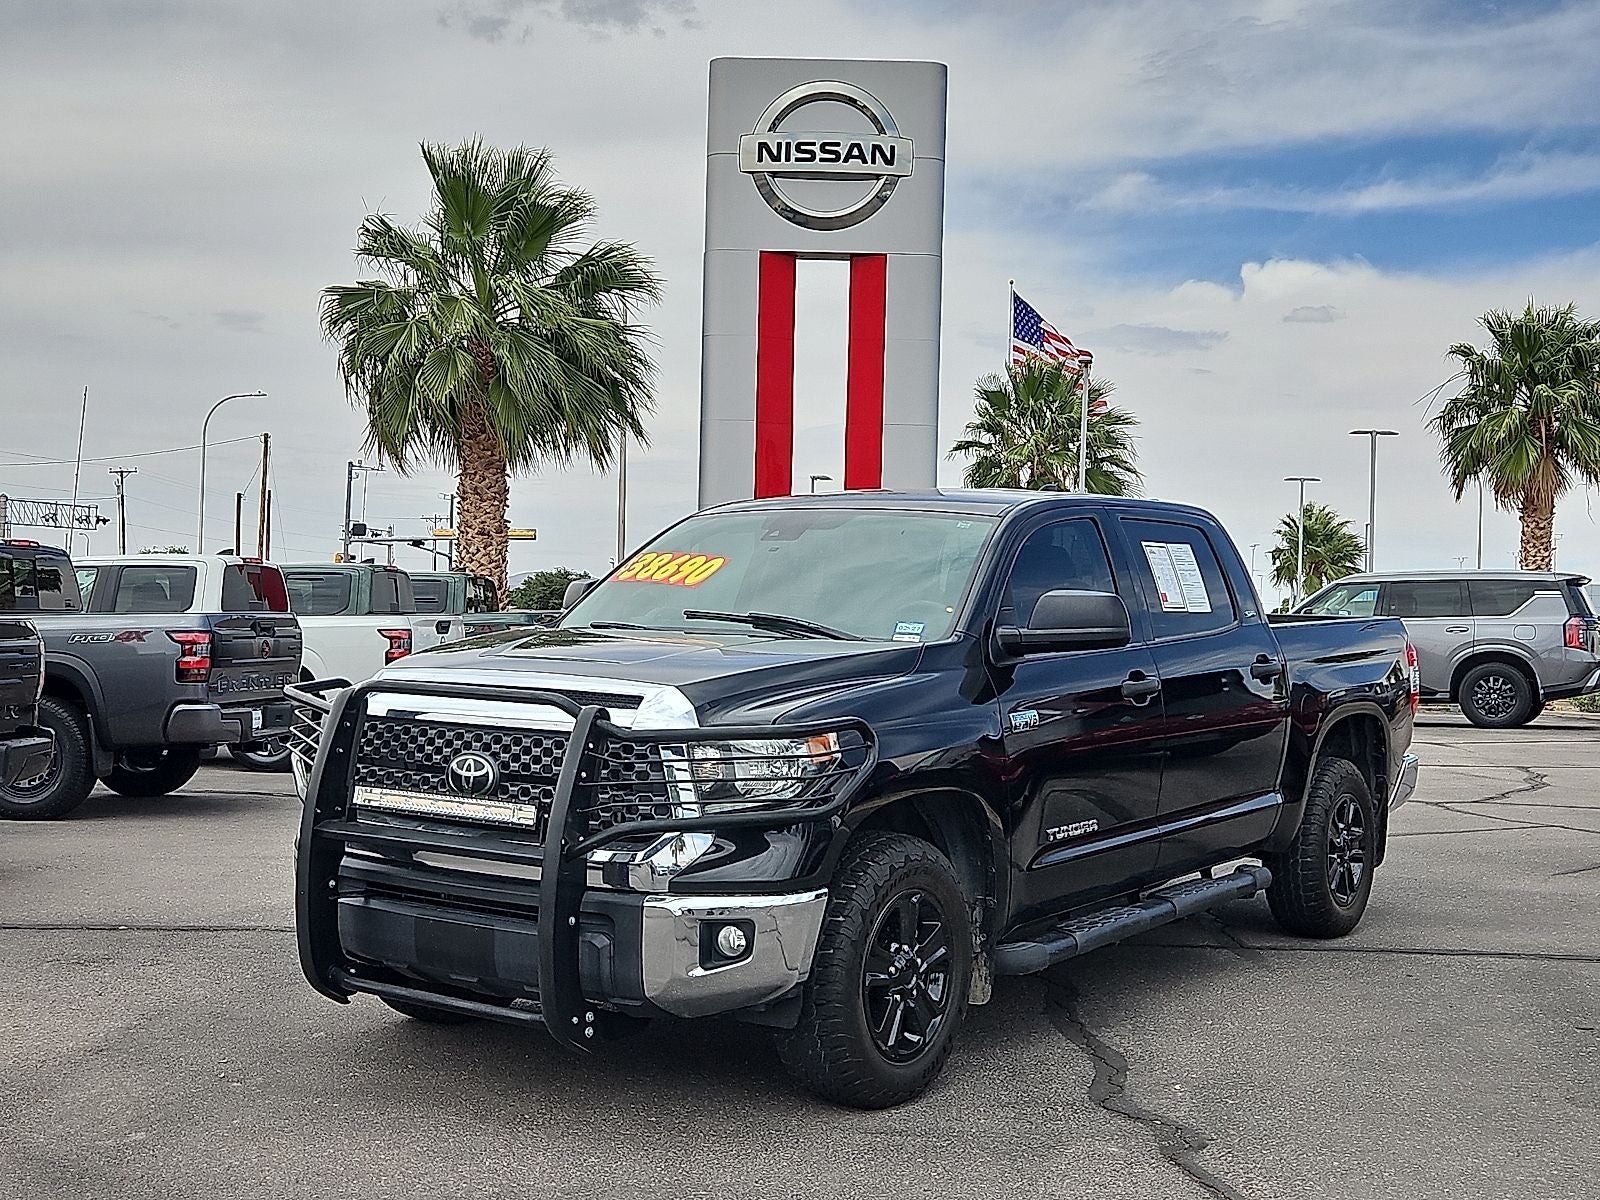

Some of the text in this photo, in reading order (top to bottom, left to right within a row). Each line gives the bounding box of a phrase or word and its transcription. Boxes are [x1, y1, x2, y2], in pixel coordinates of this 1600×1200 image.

[756, 140, 897, 167] NISSAN
[617, 551, 726, 586] 38690
[1046, 819, 1099, 842] TUNDRA
